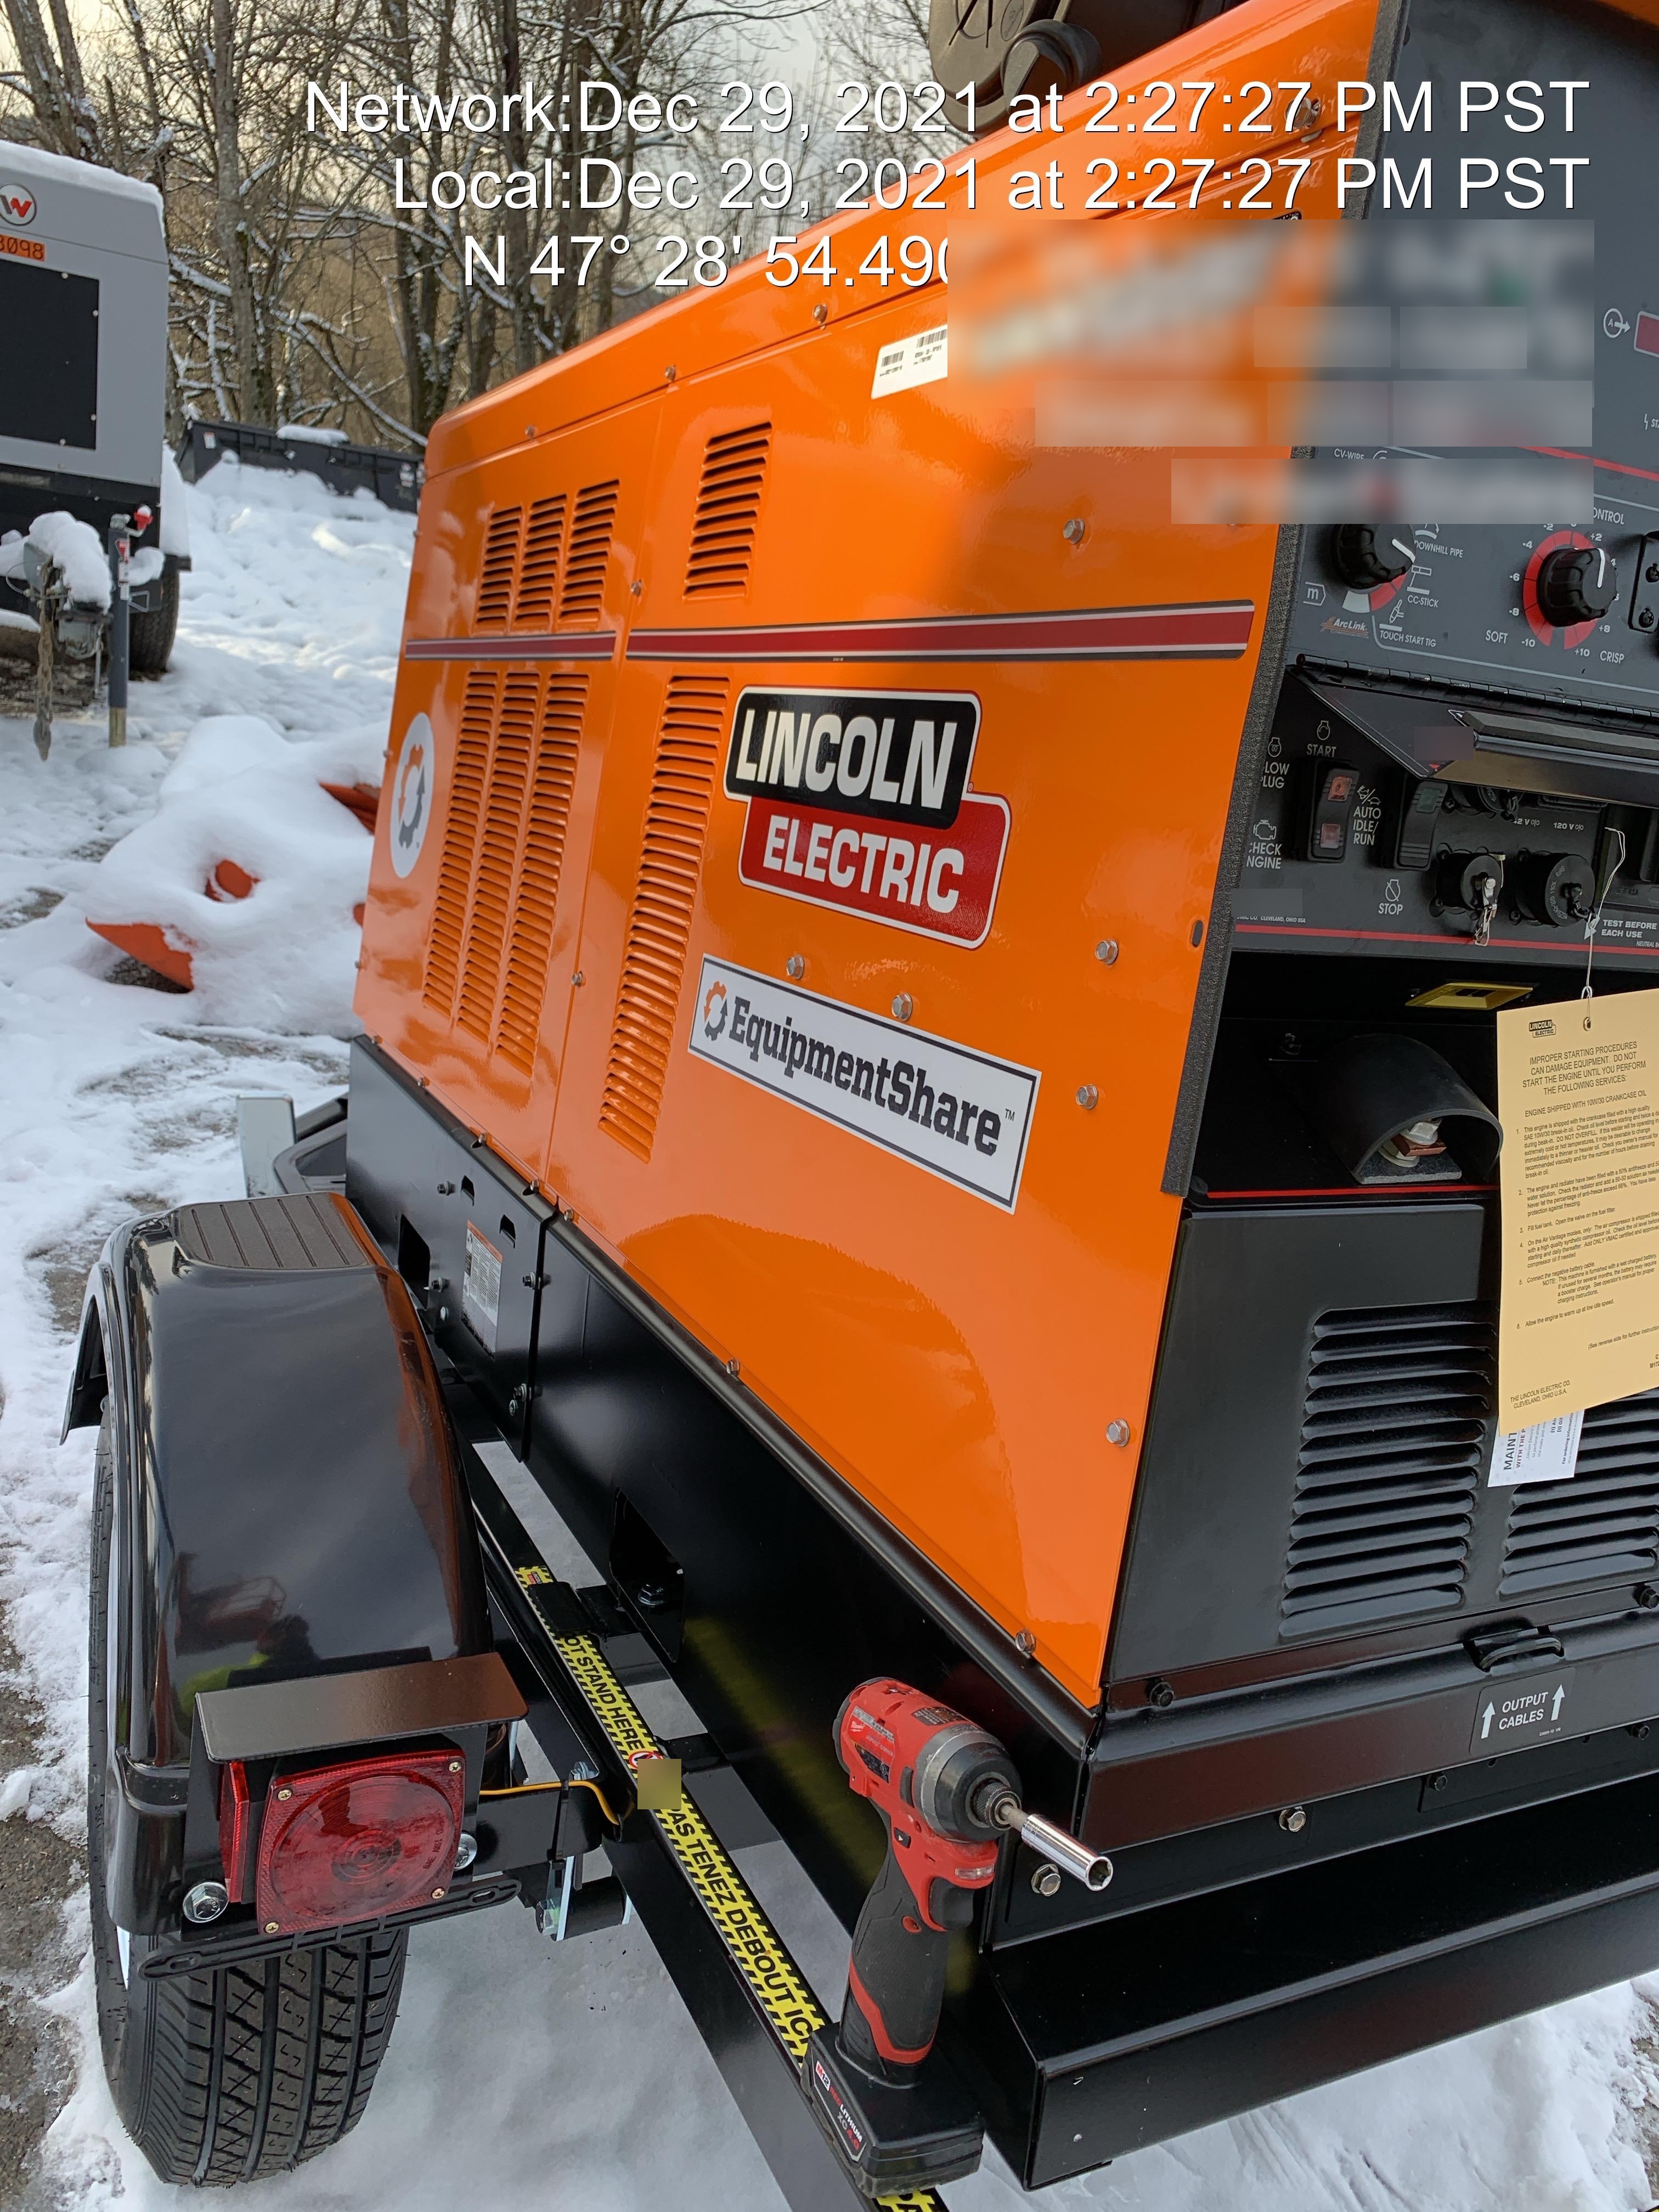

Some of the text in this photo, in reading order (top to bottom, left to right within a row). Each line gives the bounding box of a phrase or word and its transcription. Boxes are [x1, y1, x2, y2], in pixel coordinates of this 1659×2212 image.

[1594, 508, 1624, 524] ONTROL
[1414, 540, 1463, 558] DOWNHILL PIPE
[1407, 595, 1439, 608] CC-STICK
[1599, 624, 1611, 633] +8
[1380, 630, 1436, 647] TOUCH START TIG
[1485, 630, 1508, 644] SOFT
[1521, 639, 1536, 647] -10
[1575, 648, 1590, 657] +10
[1600, 651, 1624, 664] CRISP
[1306, 744, 1336, 758] START
[736, 709, 957, 809] LINCOLN
[1263, 761, 1289, 775] LOW
[1261, 776, 1285, 789] LUG
[1353, 807, 1381, 820] AUTO
[1353, 820, 1379, 835] IDLE/
[1353, 833, 1375, 846] RUN
[763, 814, 964, 914] ELECTRIC
[1246, 855, 1282, 870] NGINE
[1378, 903, 1403, 916] STOP
[1603, 919, 1657, 930] TEST BEFORE
[1601, 929, 1623, 937] EACH
[1530, 1020, 1552, 1031] LINCOLN
[1530, 1041, 1638, 1065] IMPROPER STARTING PROCEDURES
[1531, 1067, 1544, 1076] CAN
[1546, 1062, 1573, 1074] DAMAGE
[1613, 1054, 1624, 1062] DO
[1624, 1051, 1637, 1060] NOT
[729, 996, 1002, 1157] EquipmentShare
[1522, 1060, 1646, 1088] START THE ENGINE UNTIL YOU PERFORM
[1543, 1074, 1628, 1096] THE FOLLOWING SERVICES:
[1525, 1089, 1646, 1118] ENGINE SHIPPED WITH 10W/30 CRANKCASE OIL
[1534, 1124, 1548, 1132] engine
[1534, 1131, 1550, 1139] 10W/30
[1536, 1184, 1550, 1192] engine
[1555, 1218, 1566, 1227] Open
[1549, 1232, 1566, 1241] Vantage
[1527, 1274, 1544, 1283] Connect
[1514, 1387, 1567, 1409] CLEVELAND, OHIO U.S.A.
[1520, 1389, 1539, 1401] LINCOLN
[1540, 1383, 1562, 1395] ELECTRIC
[564, 1636, 645, 1751] OT STAND HERE
[1502, 1691, 1548, 1713] OUTPUT
[1499, 1709, 1544, 1730] CABLES
[667, 1809, 695, 1837] AS
[686, 1841, 730, 1907] TENEZ
[726, 1909, 797, 2004] DEBOUT
[816, 2064, 830, 2085] M12
